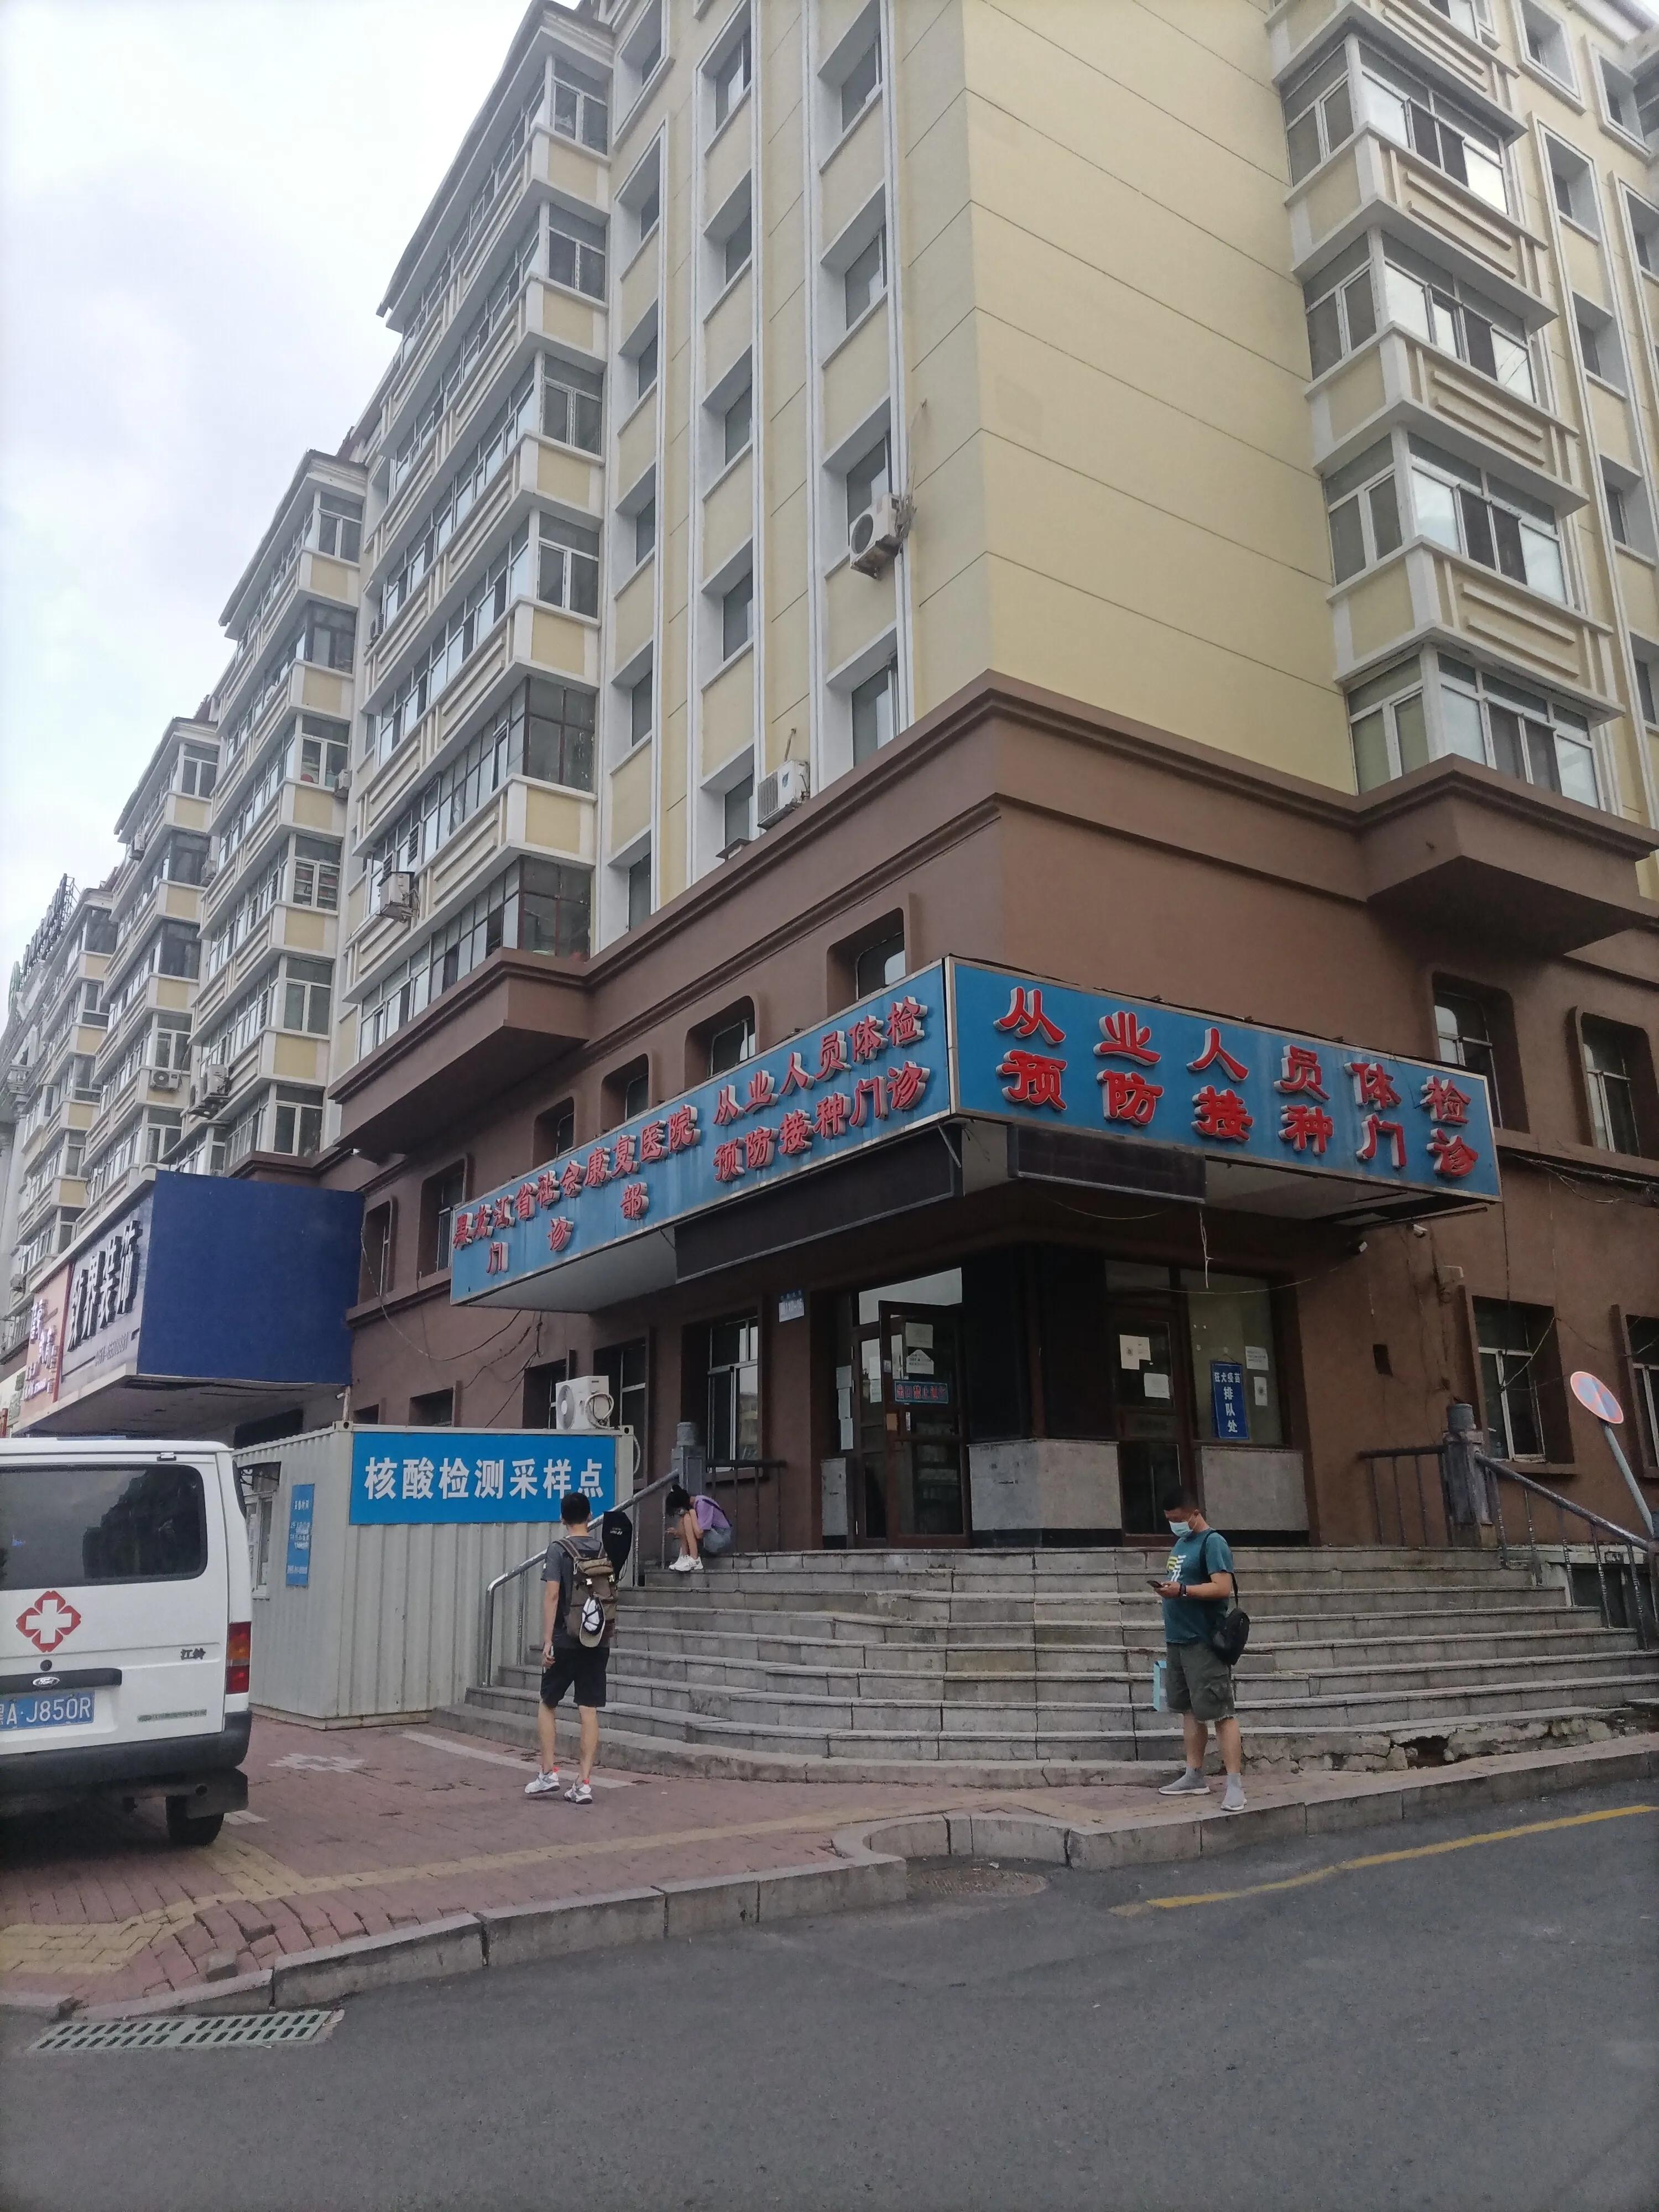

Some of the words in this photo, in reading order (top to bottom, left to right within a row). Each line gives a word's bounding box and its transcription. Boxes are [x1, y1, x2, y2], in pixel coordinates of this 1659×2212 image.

[713, 995, 928, 1126] 从业人员体检
[994, 985, 1471, 1126] 从业人员体检
[997, 1049, 1479, 1178] 预防接种门诊
[452, 1104, 701, 1250] 黑龙江省社会康复医院
[713, 1060, 931, 1182] 预防接种门诊
[487, 1182, 649, 1275] 门诊部
[1214, 1371, 1240, 1383] 狂犬疫苗
[1223, 1386, 1238, 1433] 排队处
[364, 1456, 604, 1500] 核酸检测采样点
